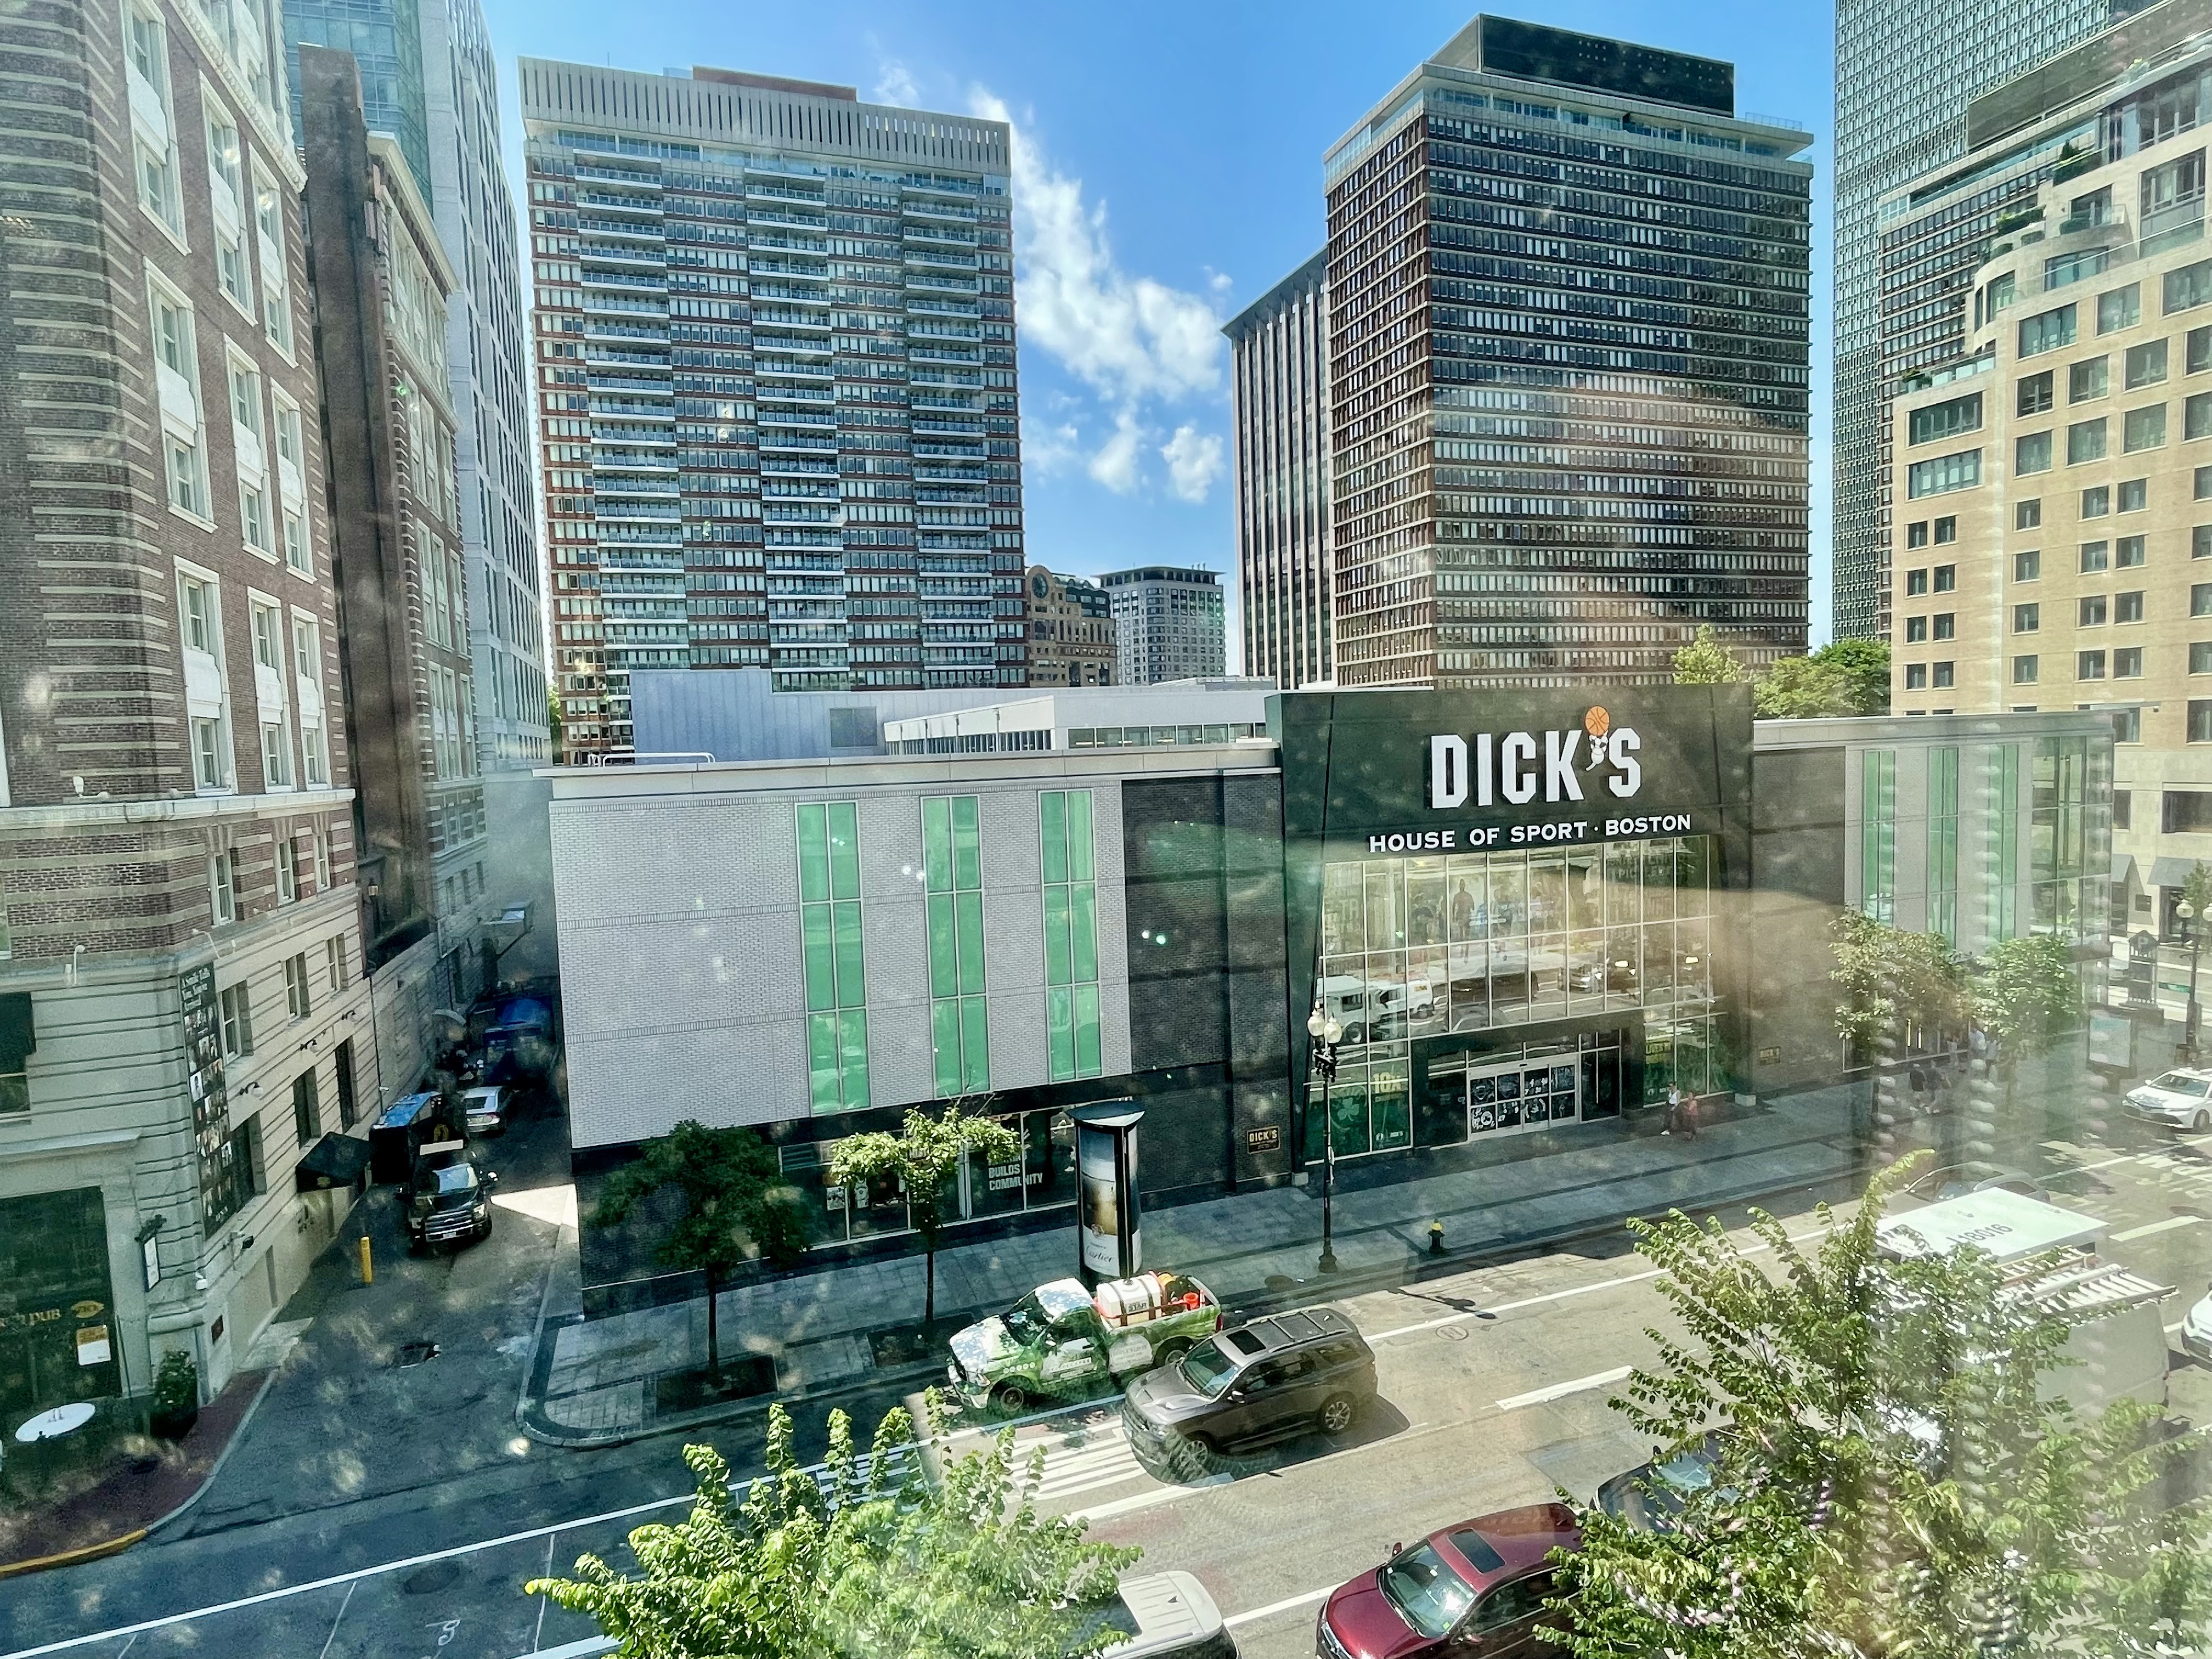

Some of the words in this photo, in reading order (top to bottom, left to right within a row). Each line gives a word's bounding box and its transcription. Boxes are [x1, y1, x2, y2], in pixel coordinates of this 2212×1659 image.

[1431, 706, 1643, 809] DICK'S
[1369, 830, 1455, 853] HOUSE
[1469, 827, 1500, 845] OF
[1510, 820, 1588, 843] SPORT
[1605, 814, 1691, 837] BOSTON
[988, 1163, 1021, 1179] BUILDS
[989, 1172, 1043, 1191] COMMUNITY
[1085, 1245, 1113, 1263] Cartier
